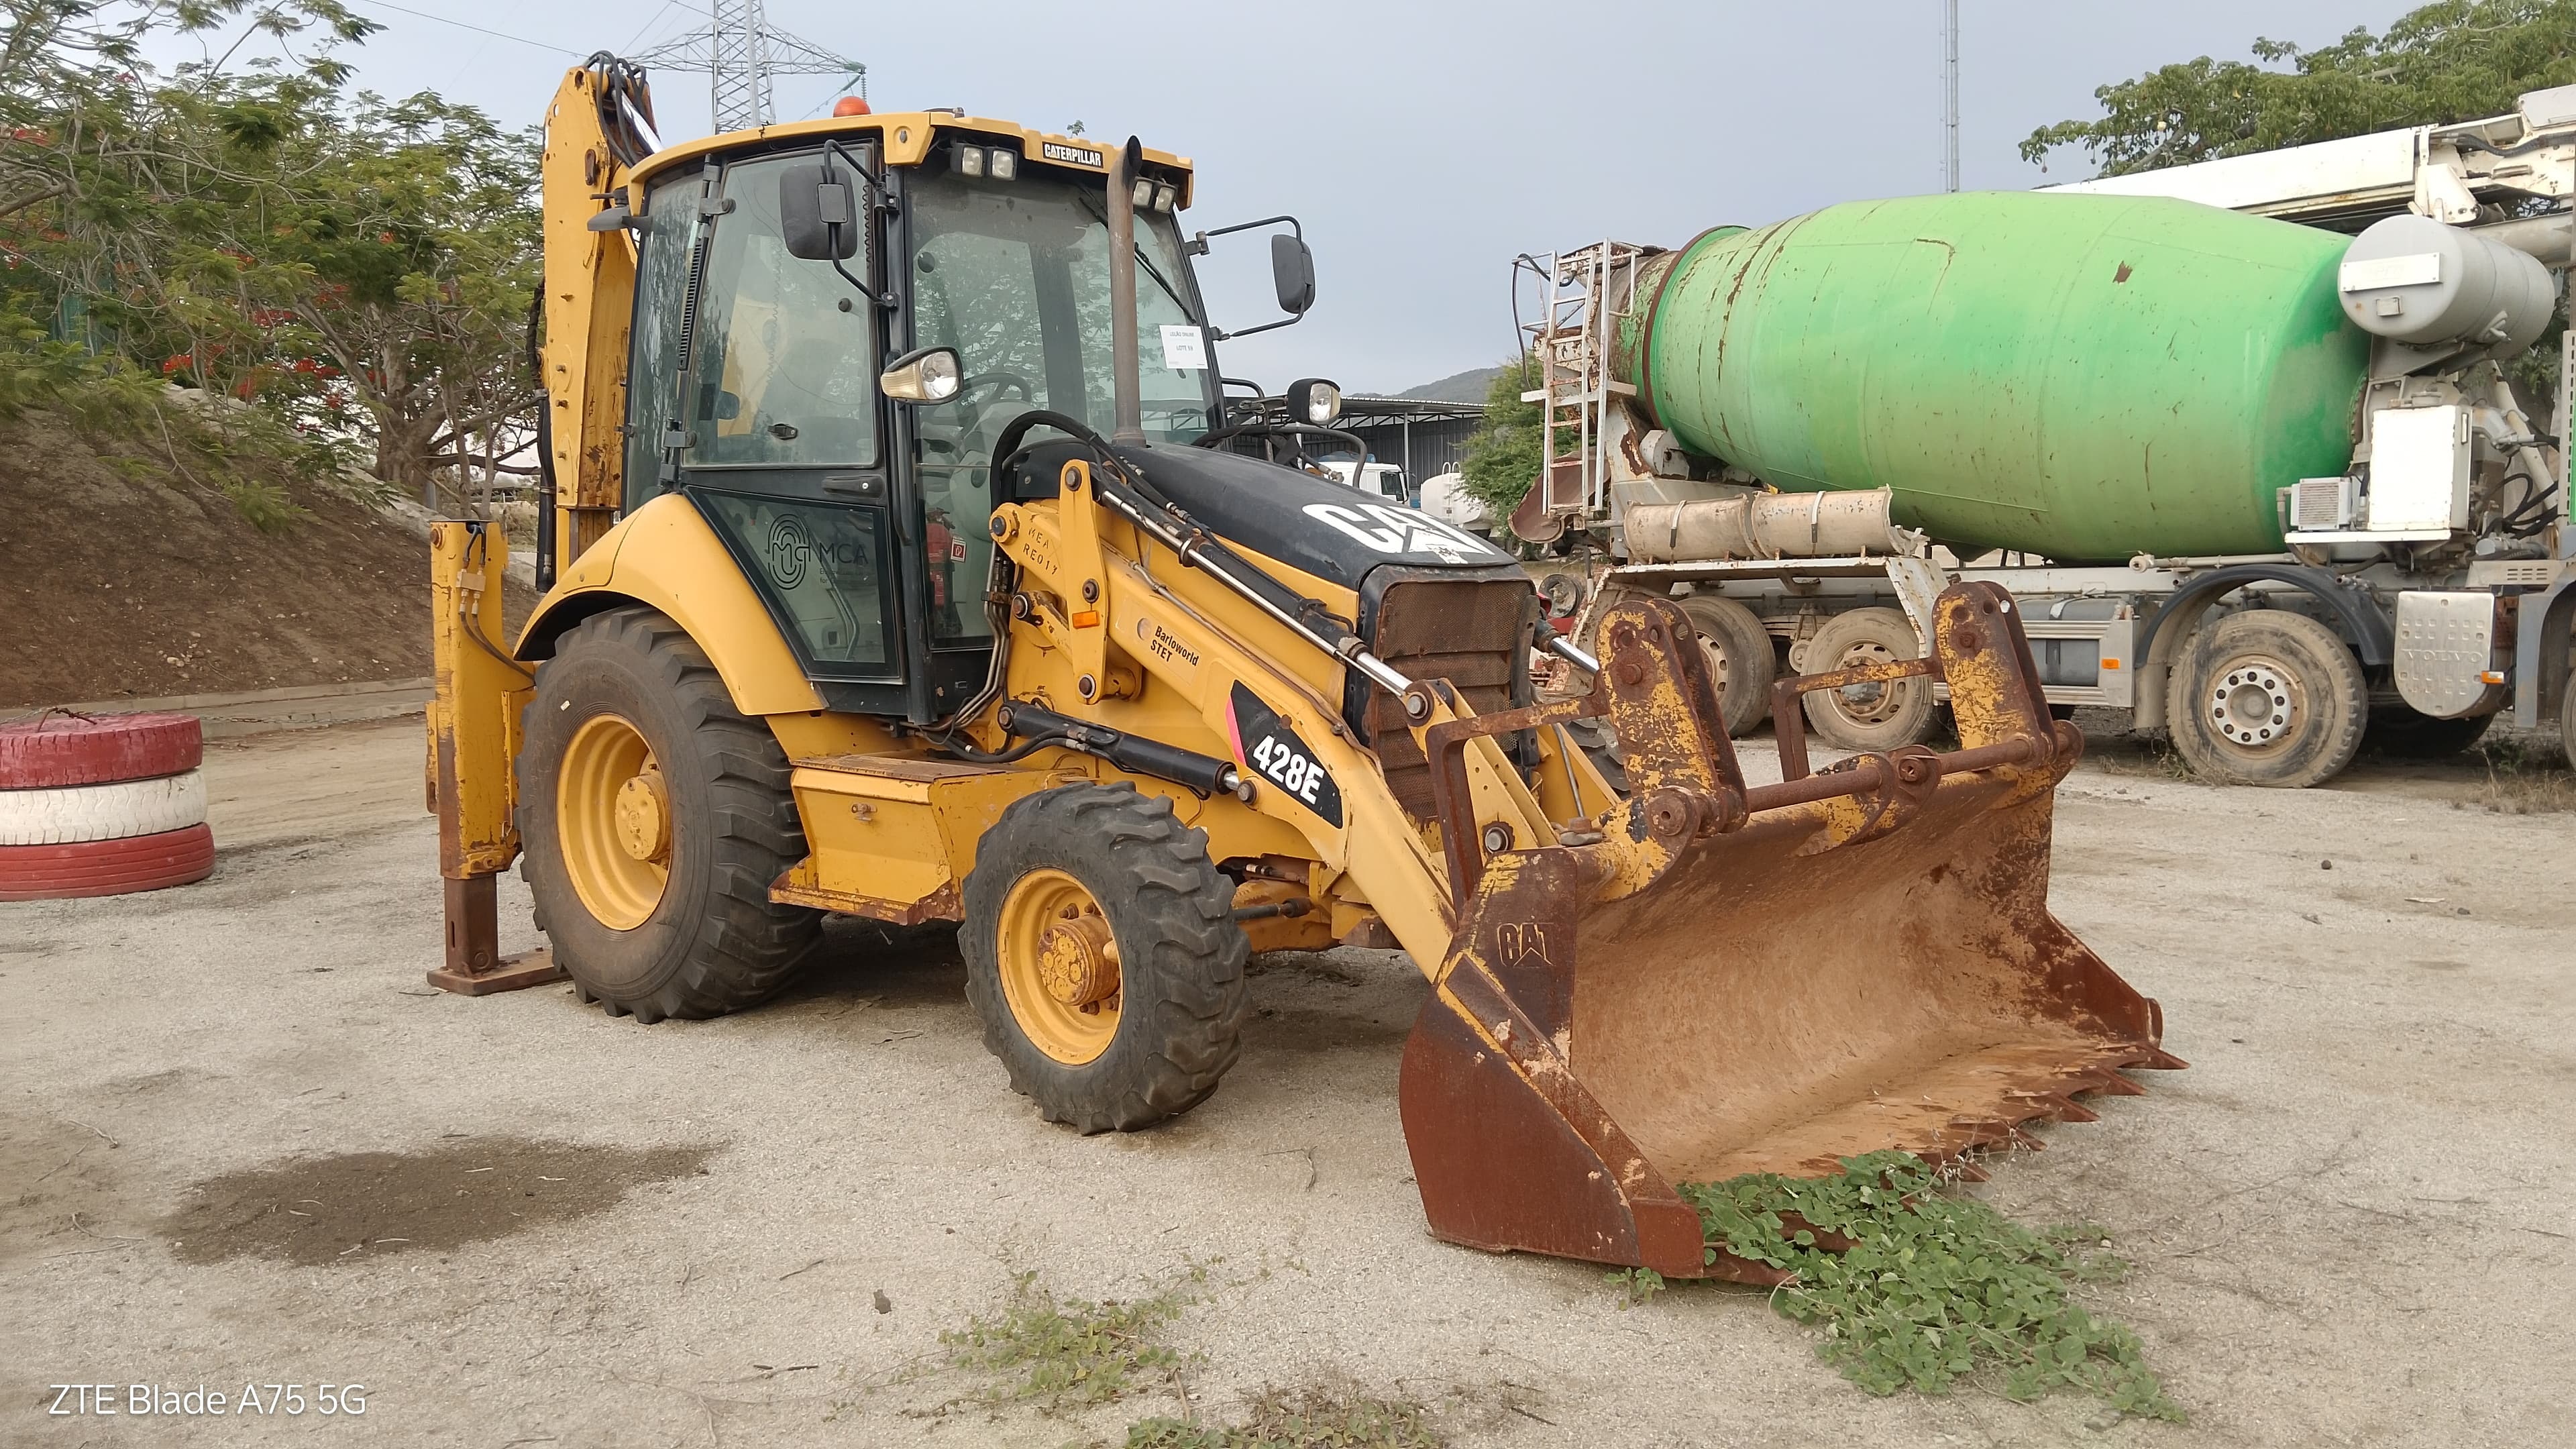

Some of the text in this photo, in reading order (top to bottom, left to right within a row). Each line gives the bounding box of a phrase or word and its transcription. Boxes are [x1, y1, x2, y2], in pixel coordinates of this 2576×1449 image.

[1044, 144, 1102, 166] CATERPILLAR
[1301, 504, 1495, 564] CAT
[819, 542, 869, 564] MCA
[1150, 639, 1173, 662] STET
[1155, 625, 1199, 666] Barloworld
[2401, 648, 2483, 663] VOLVO
[1252, 735, 1325, 805] 428E
[1497, 922, 1556, 968] CAT
